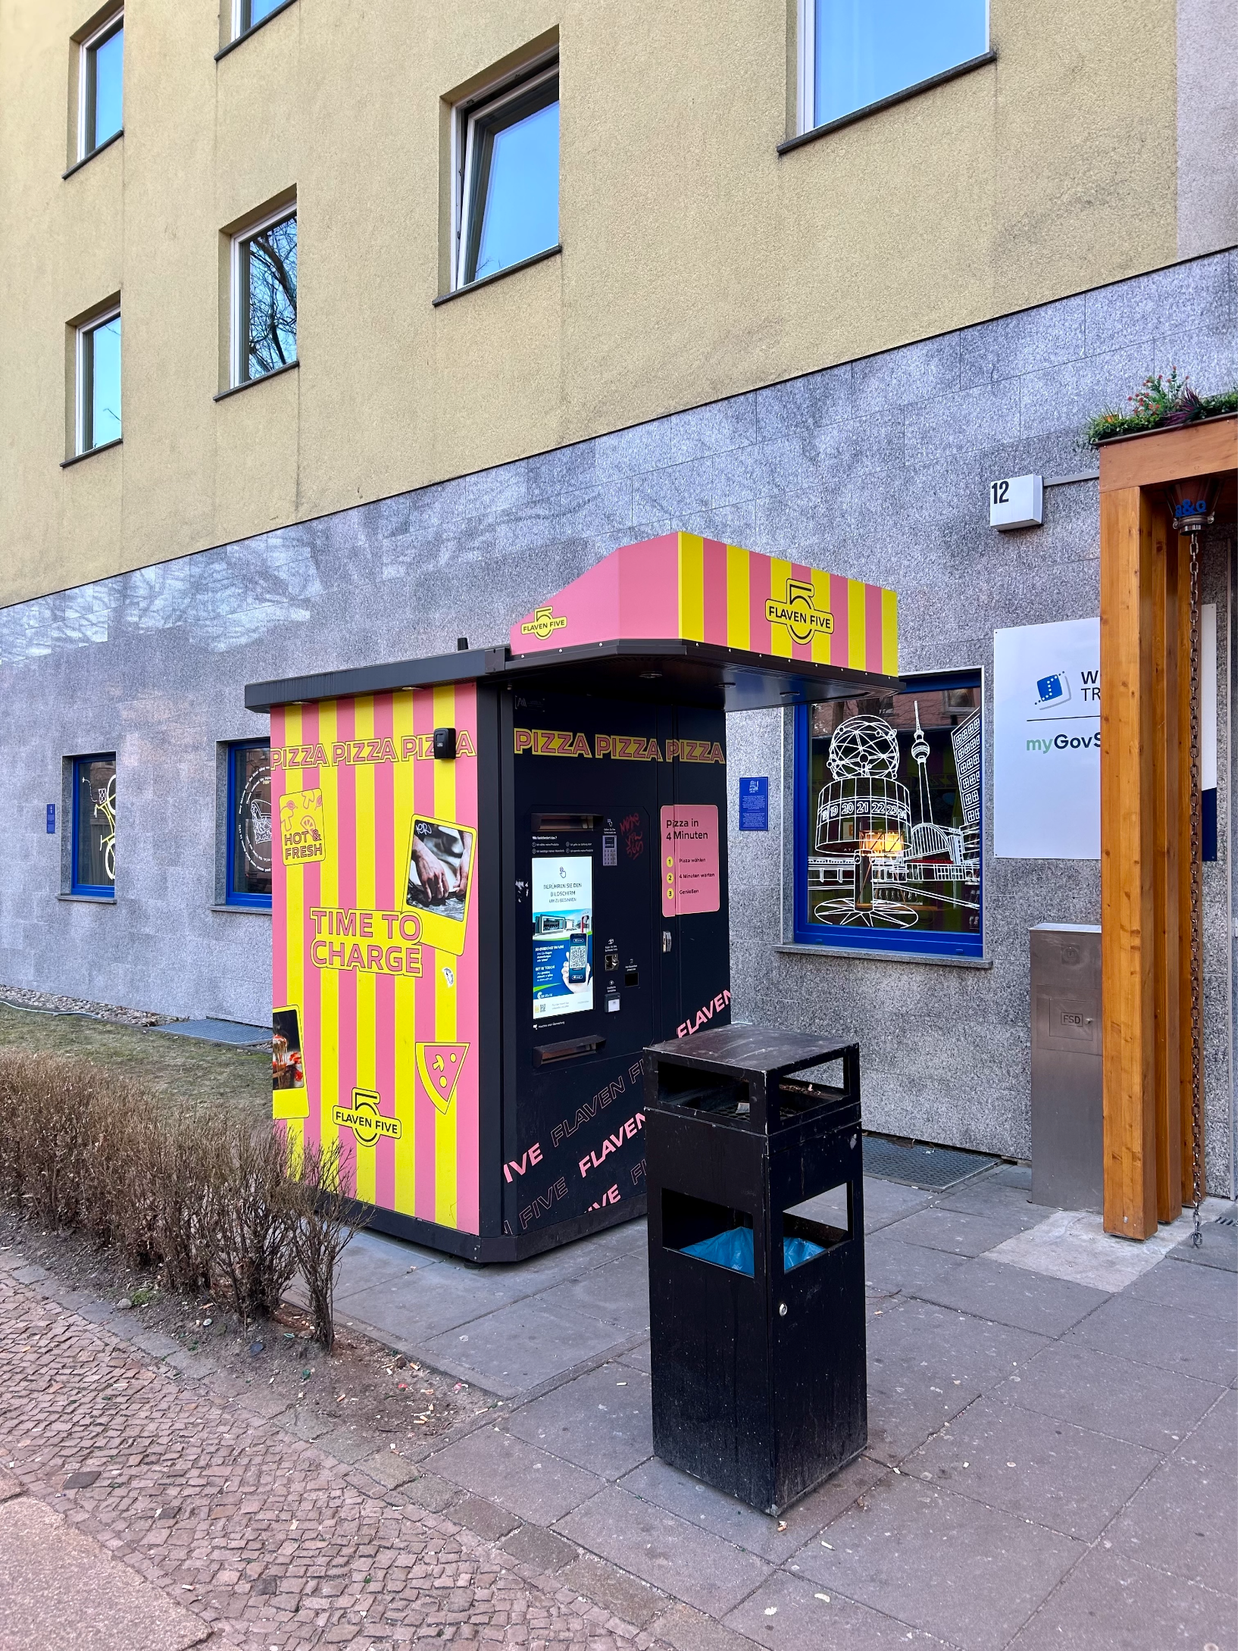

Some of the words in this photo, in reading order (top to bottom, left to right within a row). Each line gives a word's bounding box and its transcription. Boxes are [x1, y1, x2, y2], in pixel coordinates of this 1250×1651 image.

[991, 480, 1009, 504] 12
[1175, 499, 1207, 518] a&o
[523, 622, 548, 632] FLAVEN
[549, 619, 565, 628] FIVE
[769, 605, 807, 624] FLAVEN
[810, 614, 831, 629] FIVE
[1080, 687, 1101, 701] TR
[271, 743, 330, 770] PIZZA
[331, 737, 399, 767] PIZZA
[401, 730, 477, 762] PIZA
[513, 727, 593, 758] PIZZA
[594, 734, 664, 762] PIZZA
[665, 739, 726, 765] PIZZA
[841, 802, 854, 815] 20
[856, 801, 869, 814] 21
[871, 802, 886, 814] 22
[691, 818, 699, 827] in
[284, 830, 307, 846] HOT
[312, 828, 322, 842] &
[666, 832, 672, 841] 4
[673, 830, 709, 840] Minuten
[285, 843, 323, 861] FRESH
[311, 910, 374, 938] TIME
[381, 914, 421, 941] TO
[312, 940, 421, 974] CHARGE
[1063, 1014, 1081, 1025] FSD
[335, 1111, 372, 1128] FLAVEN
[375, 1120, 398, 1134] FIVE
[503, 1142, 544, 1183] IVE
[550, 1075, 626, 1148] FLAVEN
[519, 1176, 569, 1230] FIVE
